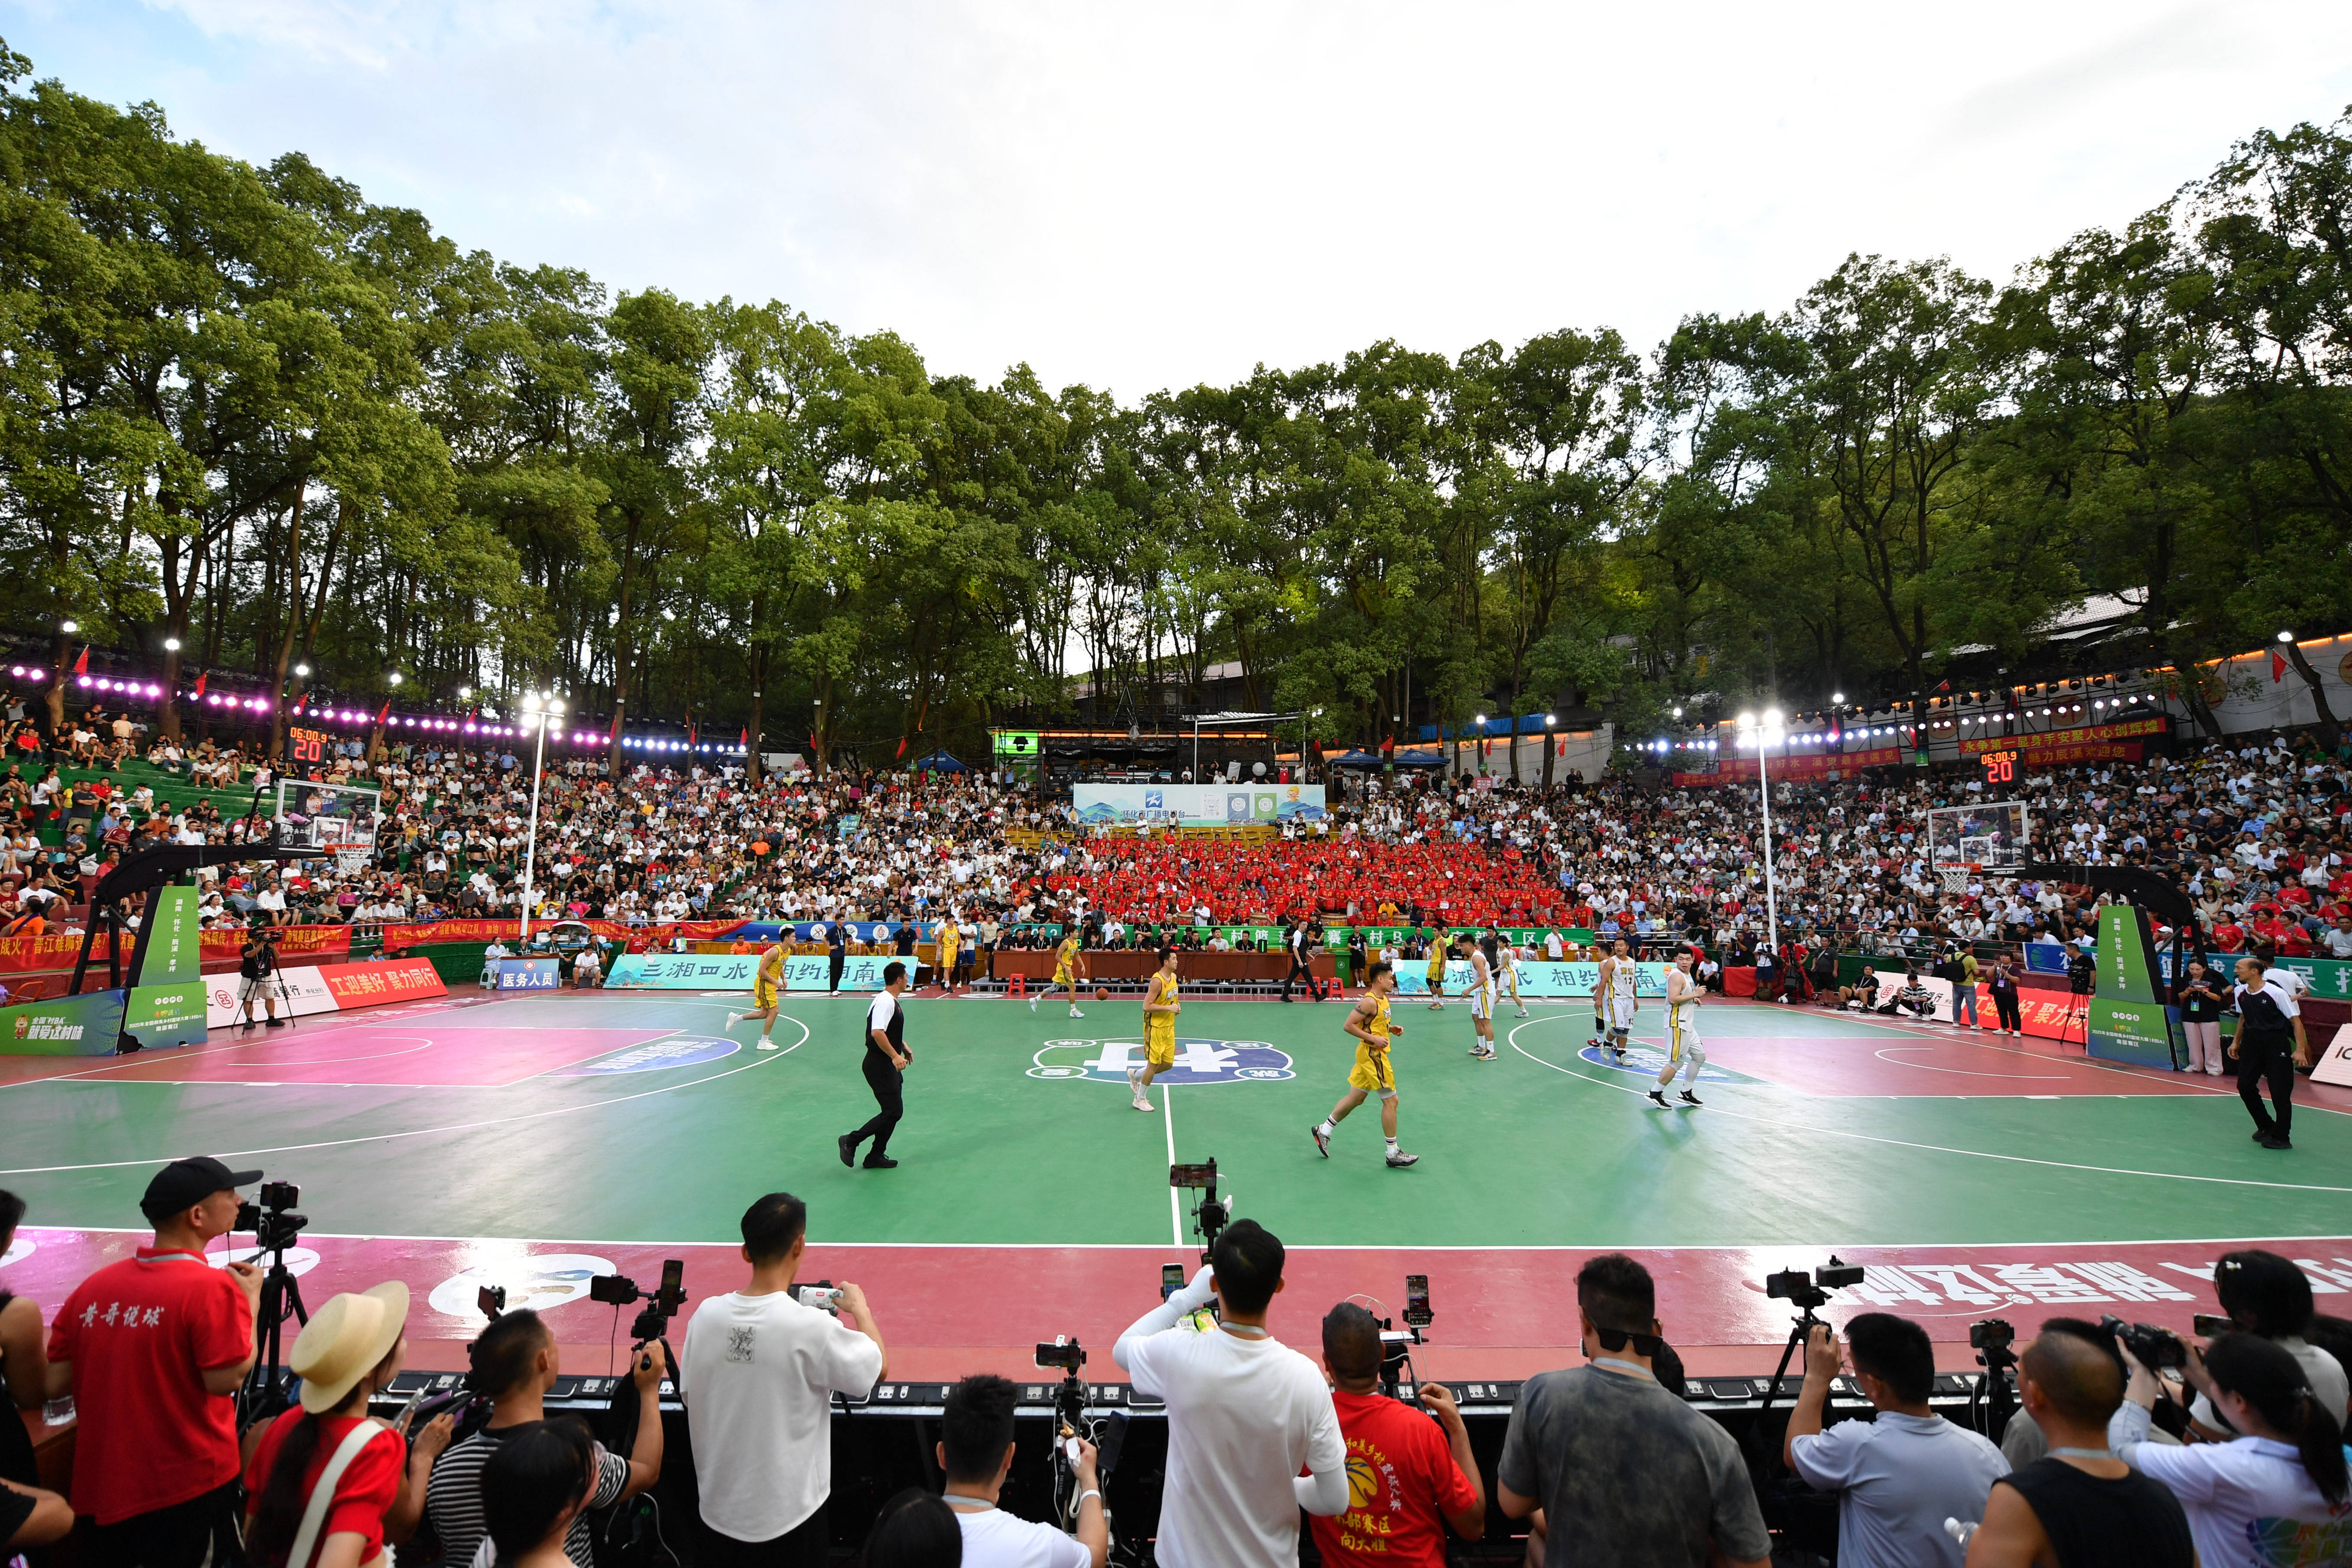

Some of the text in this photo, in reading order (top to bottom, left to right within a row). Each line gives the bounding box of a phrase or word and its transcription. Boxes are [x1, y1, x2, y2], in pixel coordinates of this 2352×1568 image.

[290, 727, 328, 743] 06:00.9
[1964, 719, 2159, 753] 永争第一显身手安聚人心创辉煌
[294, 739, 321, 762] 20
[1981, 751, 2017, 765] 06:00.9
[2028, 746, 2126, 764] 魅力辰溪欢迎您
[1987, 761, 2013, 783] 20
[502, 972, 553, 988] 医务人员
[640, 962, 750, 981] 三湘四水
[1551, 967, 1658, 988] 相约南
[1624, 977, 1633, 985] 13
[329, 967, 439, 996] 工迎美好 聚力同行
[27, 1025, 84, 1040] 就爱这村味
[1340, 1531, 1388, 1552] 向大姐
